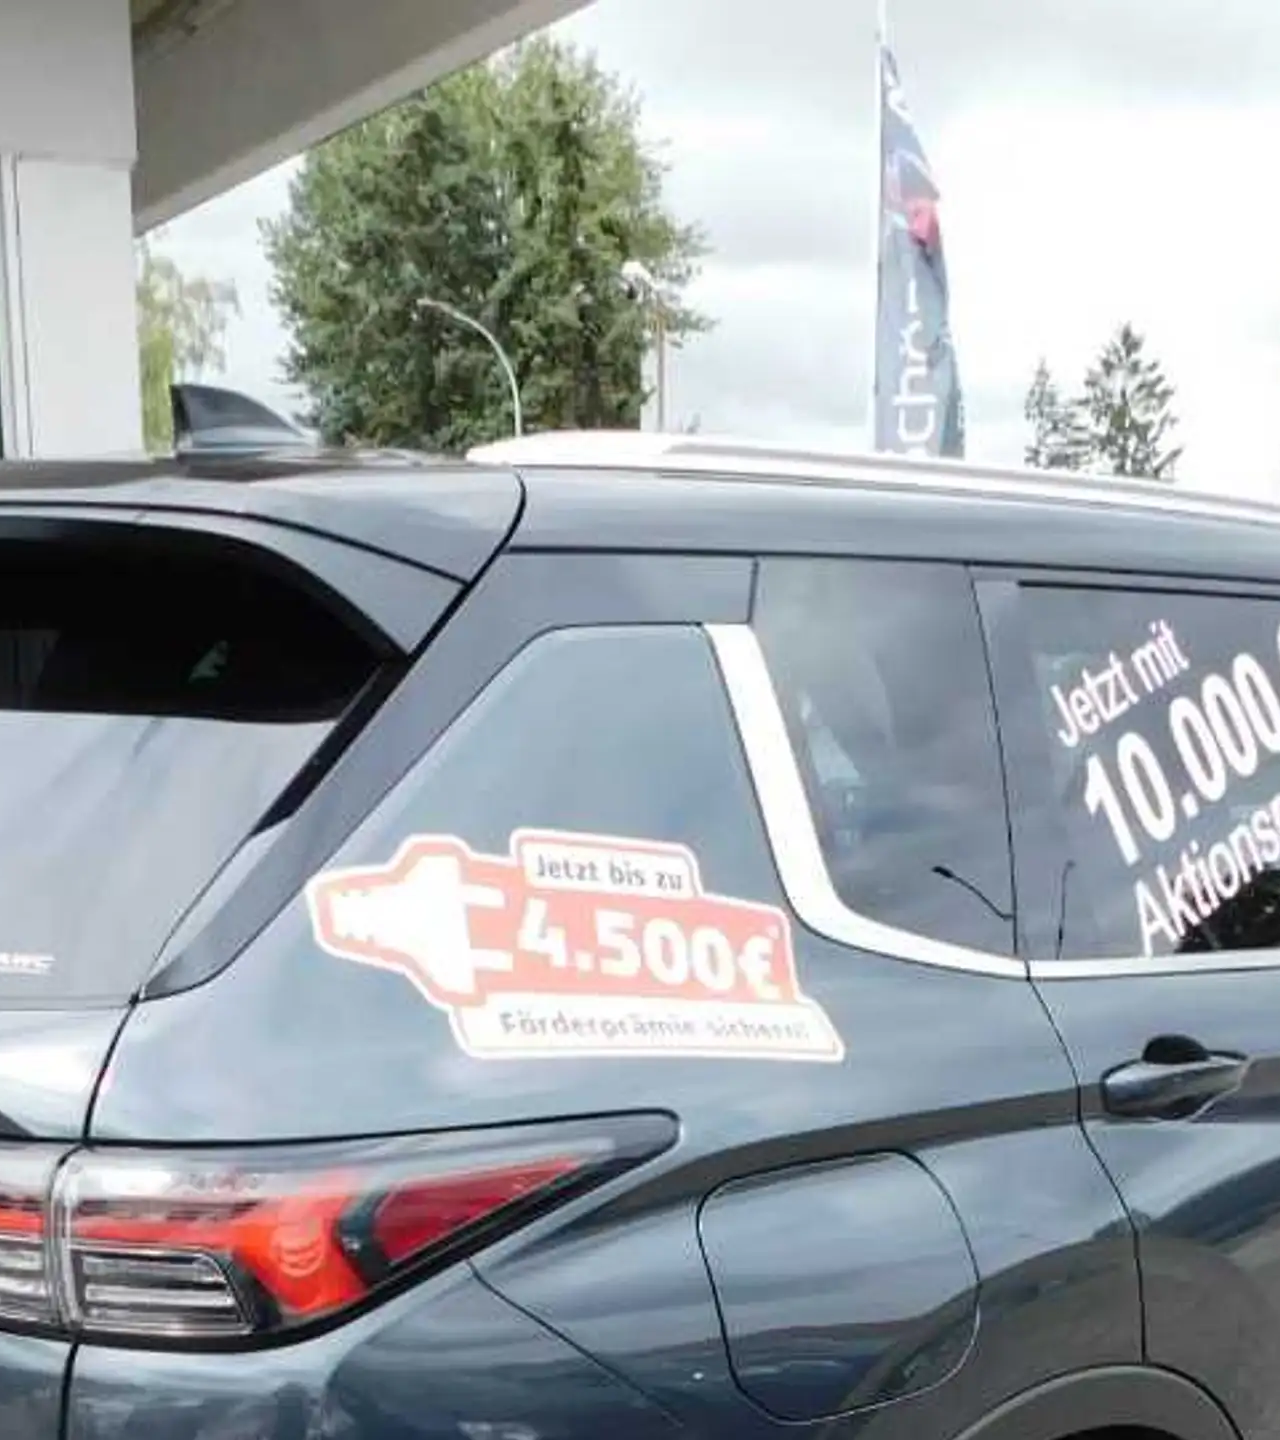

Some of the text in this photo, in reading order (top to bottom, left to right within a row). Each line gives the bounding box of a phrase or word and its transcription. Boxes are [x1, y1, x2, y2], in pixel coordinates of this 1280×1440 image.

[1050, 619, 1191, 747] Jetzt mit
[535, 853, 683, 891] Jetzt bis zu
